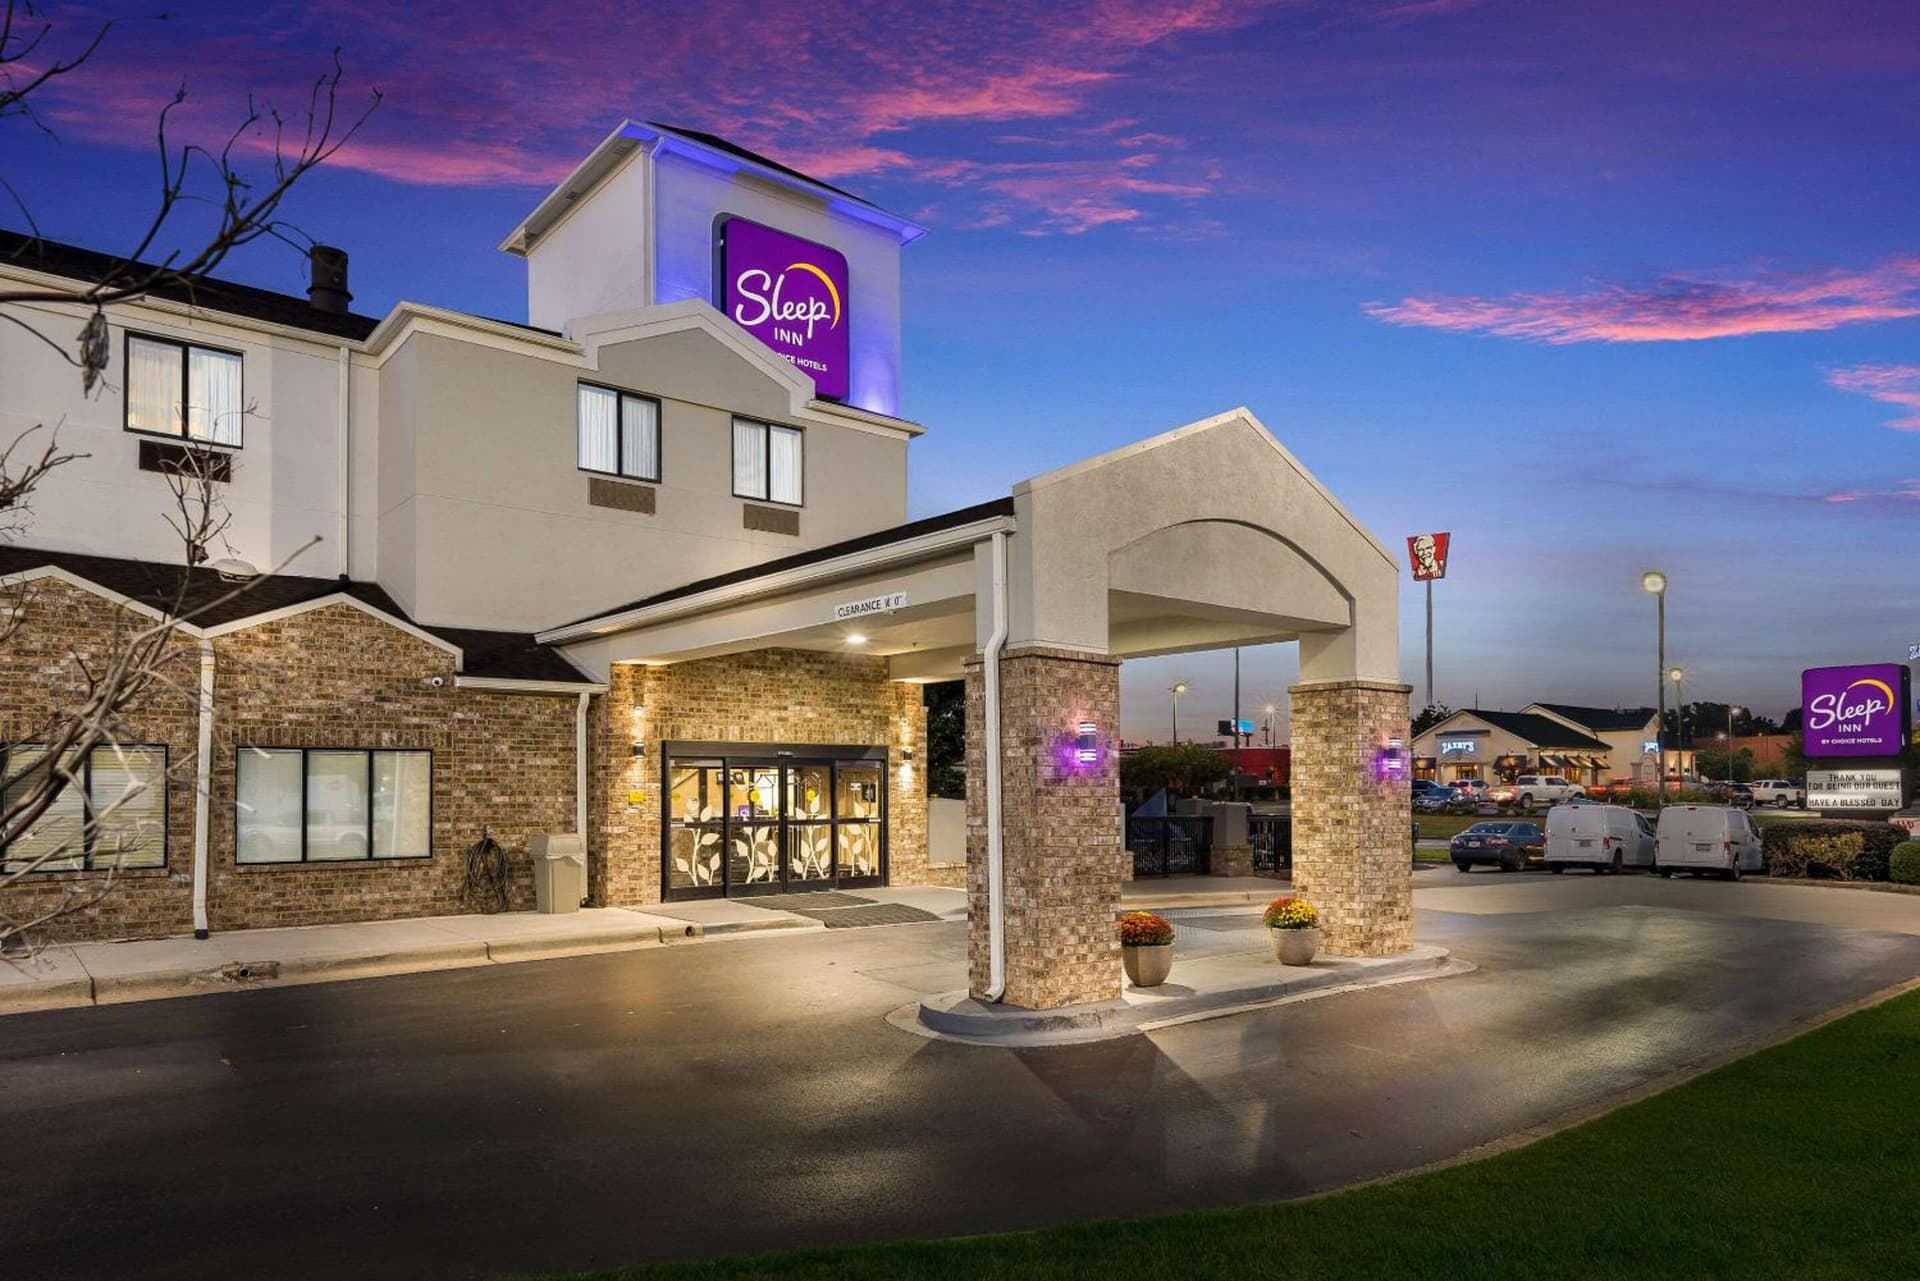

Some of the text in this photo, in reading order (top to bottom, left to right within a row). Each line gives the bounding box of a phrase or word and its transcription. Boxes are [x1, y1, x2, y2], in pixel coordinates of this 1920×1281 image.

[735, 270, 830, 338] Sleep
[774, 327, 803, 346] INN
[797, 357, 827, 371] HOTELS
[838, 600, 881, 616] CLEARANCE
[1810, 692, 1885, 728] Sleep
[1838, 723, 1862, 732] INN
[1829, 773, 1877, 782] THANK YOU
[1808, 799, 1830, 807] HAVE
[1881, 799, 1899, 807] DAY
